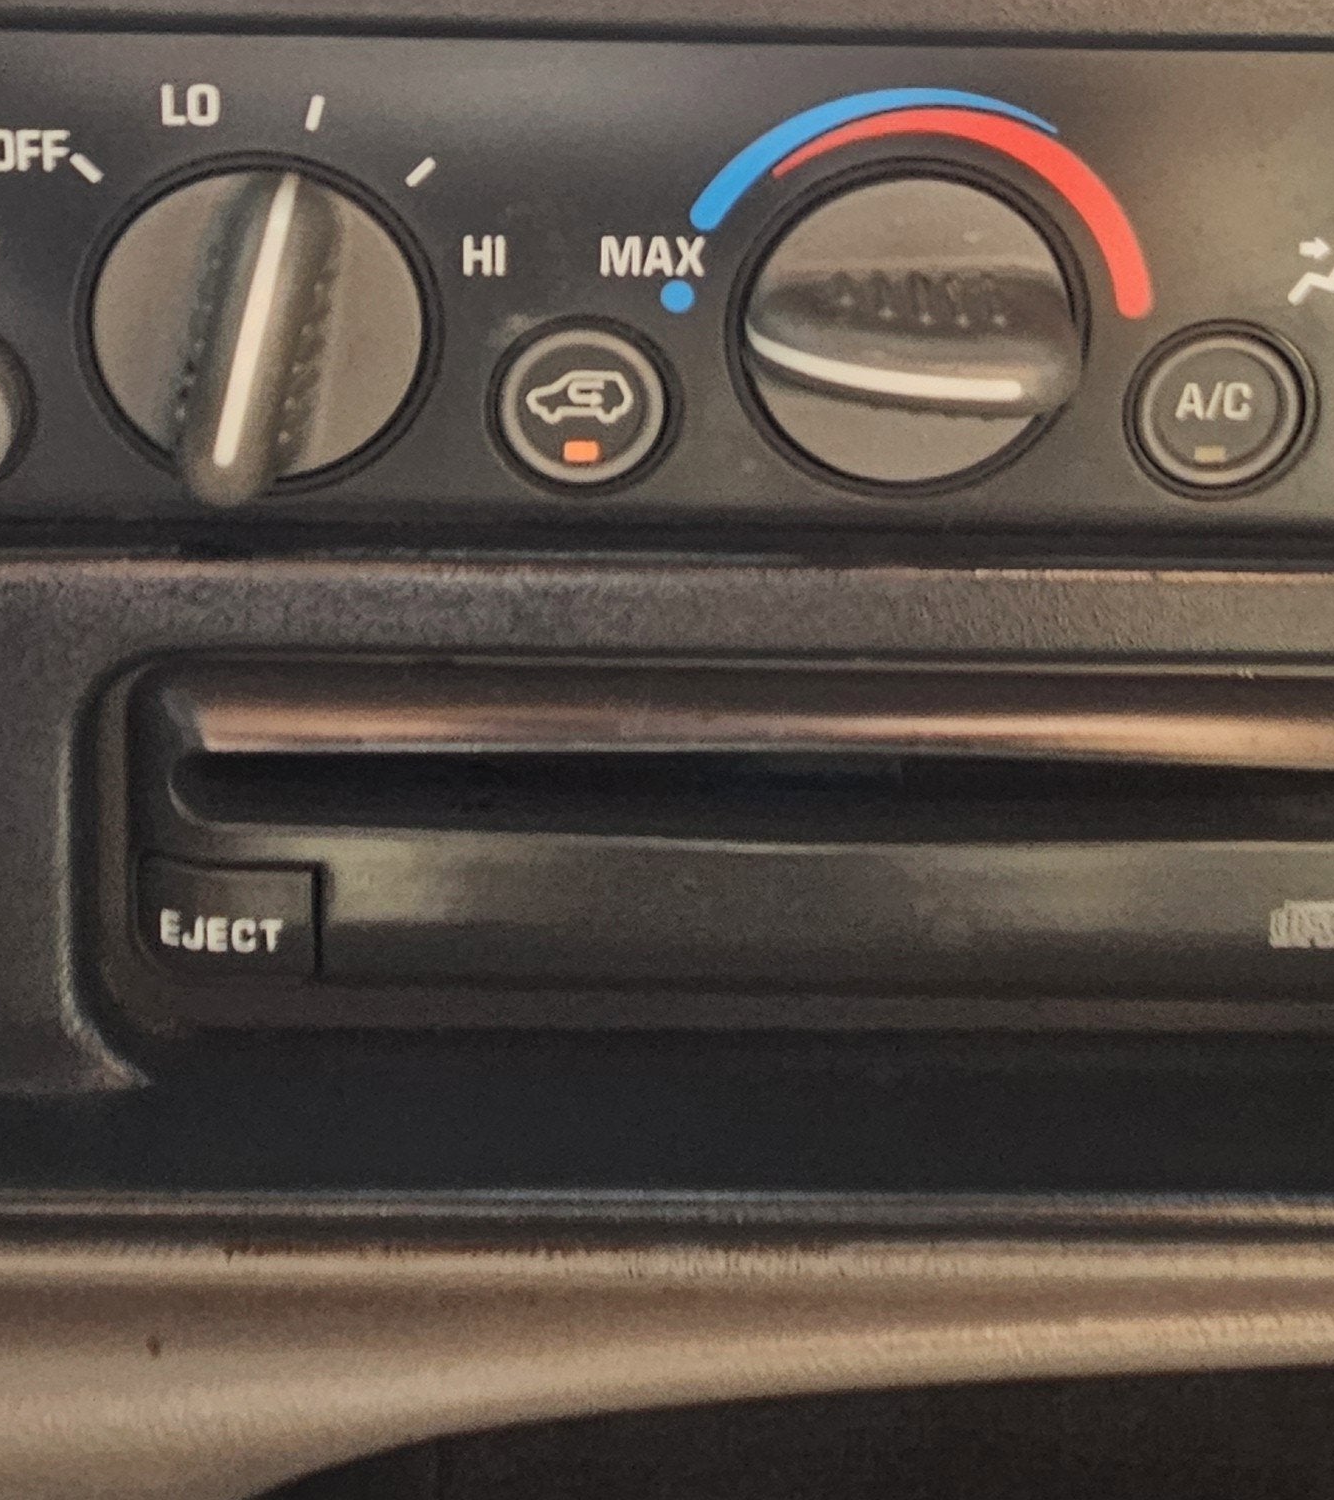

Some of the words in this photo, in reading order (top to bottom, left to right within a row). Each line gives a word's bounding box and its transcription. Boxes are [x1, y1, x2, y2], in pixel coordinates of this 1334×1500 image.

[160, 83, 221, 127] LO
[462, 235, 506, 276] HI
[600, 236, 705, 278] MAX
[1175, 381, 1252, 421] A/C
[159, 907, 284, 953] EJECT
